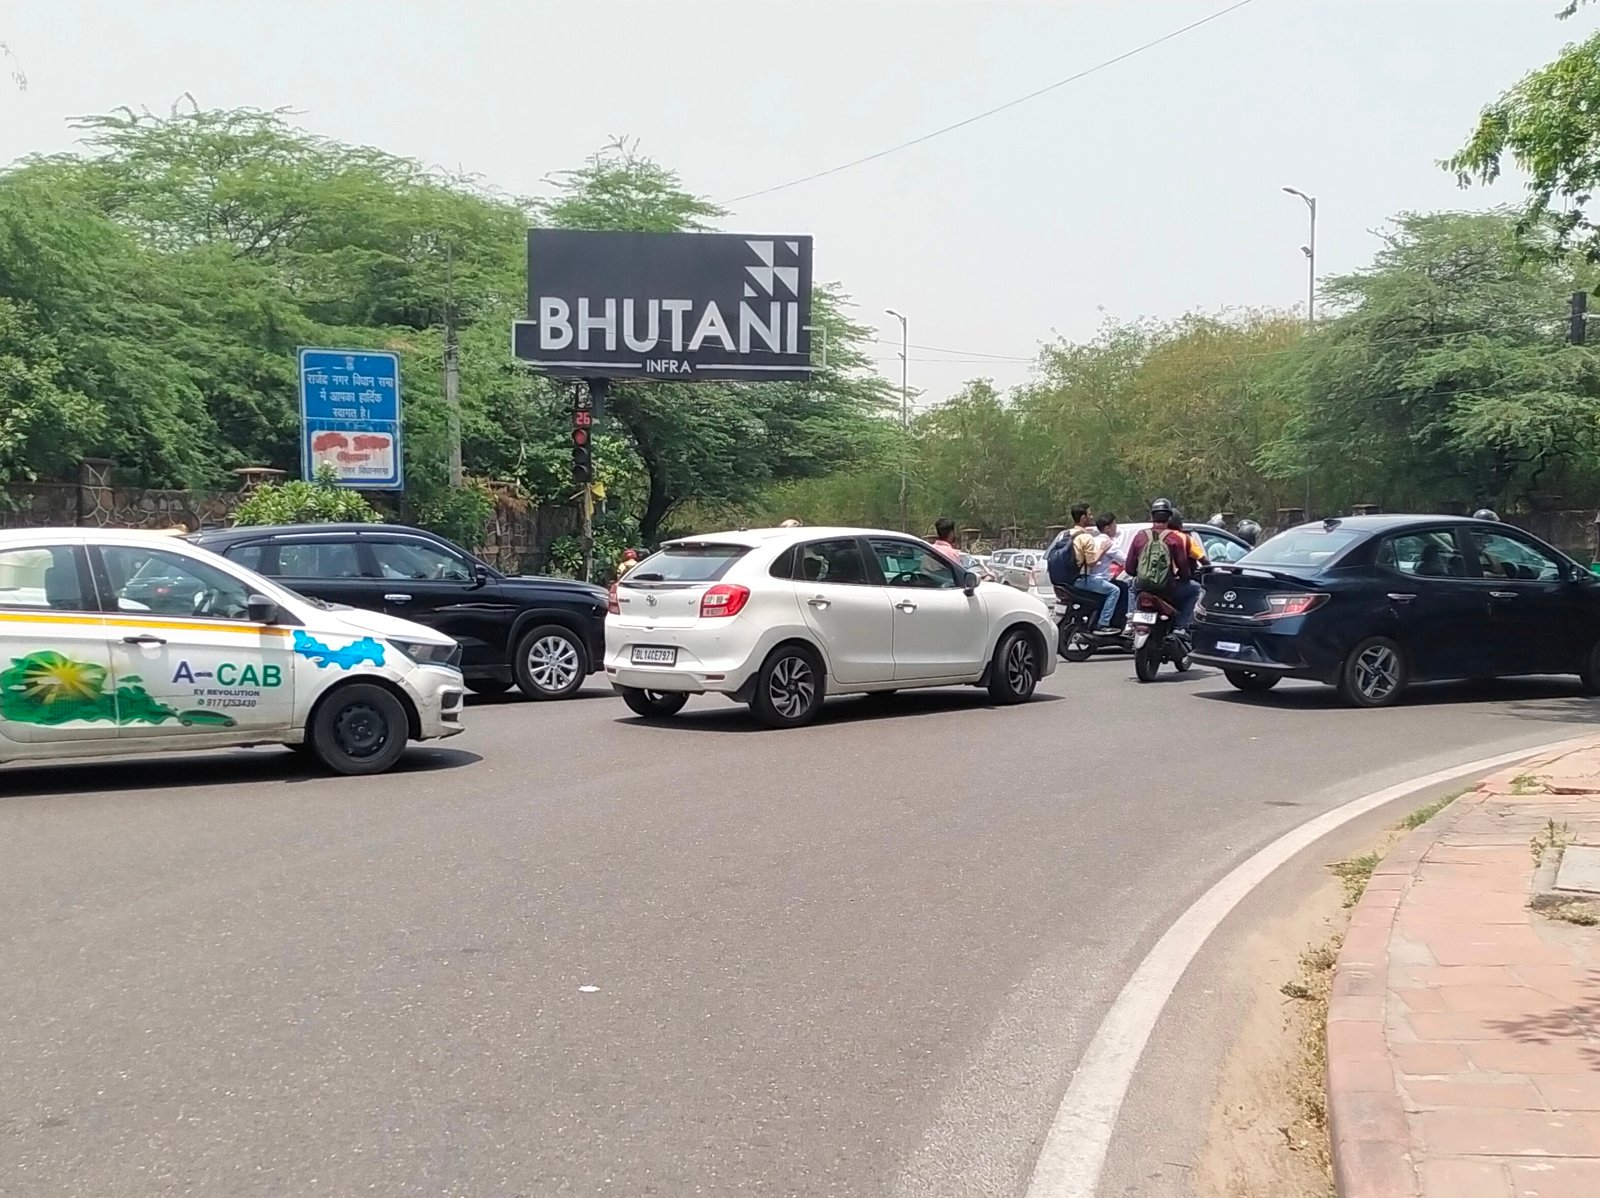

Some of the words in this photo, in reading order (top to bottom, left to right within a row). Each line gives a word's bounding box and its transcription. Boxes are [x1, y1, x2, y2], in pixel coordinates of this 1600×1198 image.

[540, 297, 798, 354] BHUTANI
[646, 359, 692, 374] INFRA
[331, 375, 349, 385] नगर
[352, 372, 374, 387] विधान
[319, 387, 327, 401] में
[330, 392, 355, 402] आपका
[358, 389, 383, 404] हार्दिक
[332, 407, 357, 418] स्वागत
[576, 411, 591, 425] 26
[194, 688, 205, 696] EV
[207, 689, 260, 697] REVOLUTION
